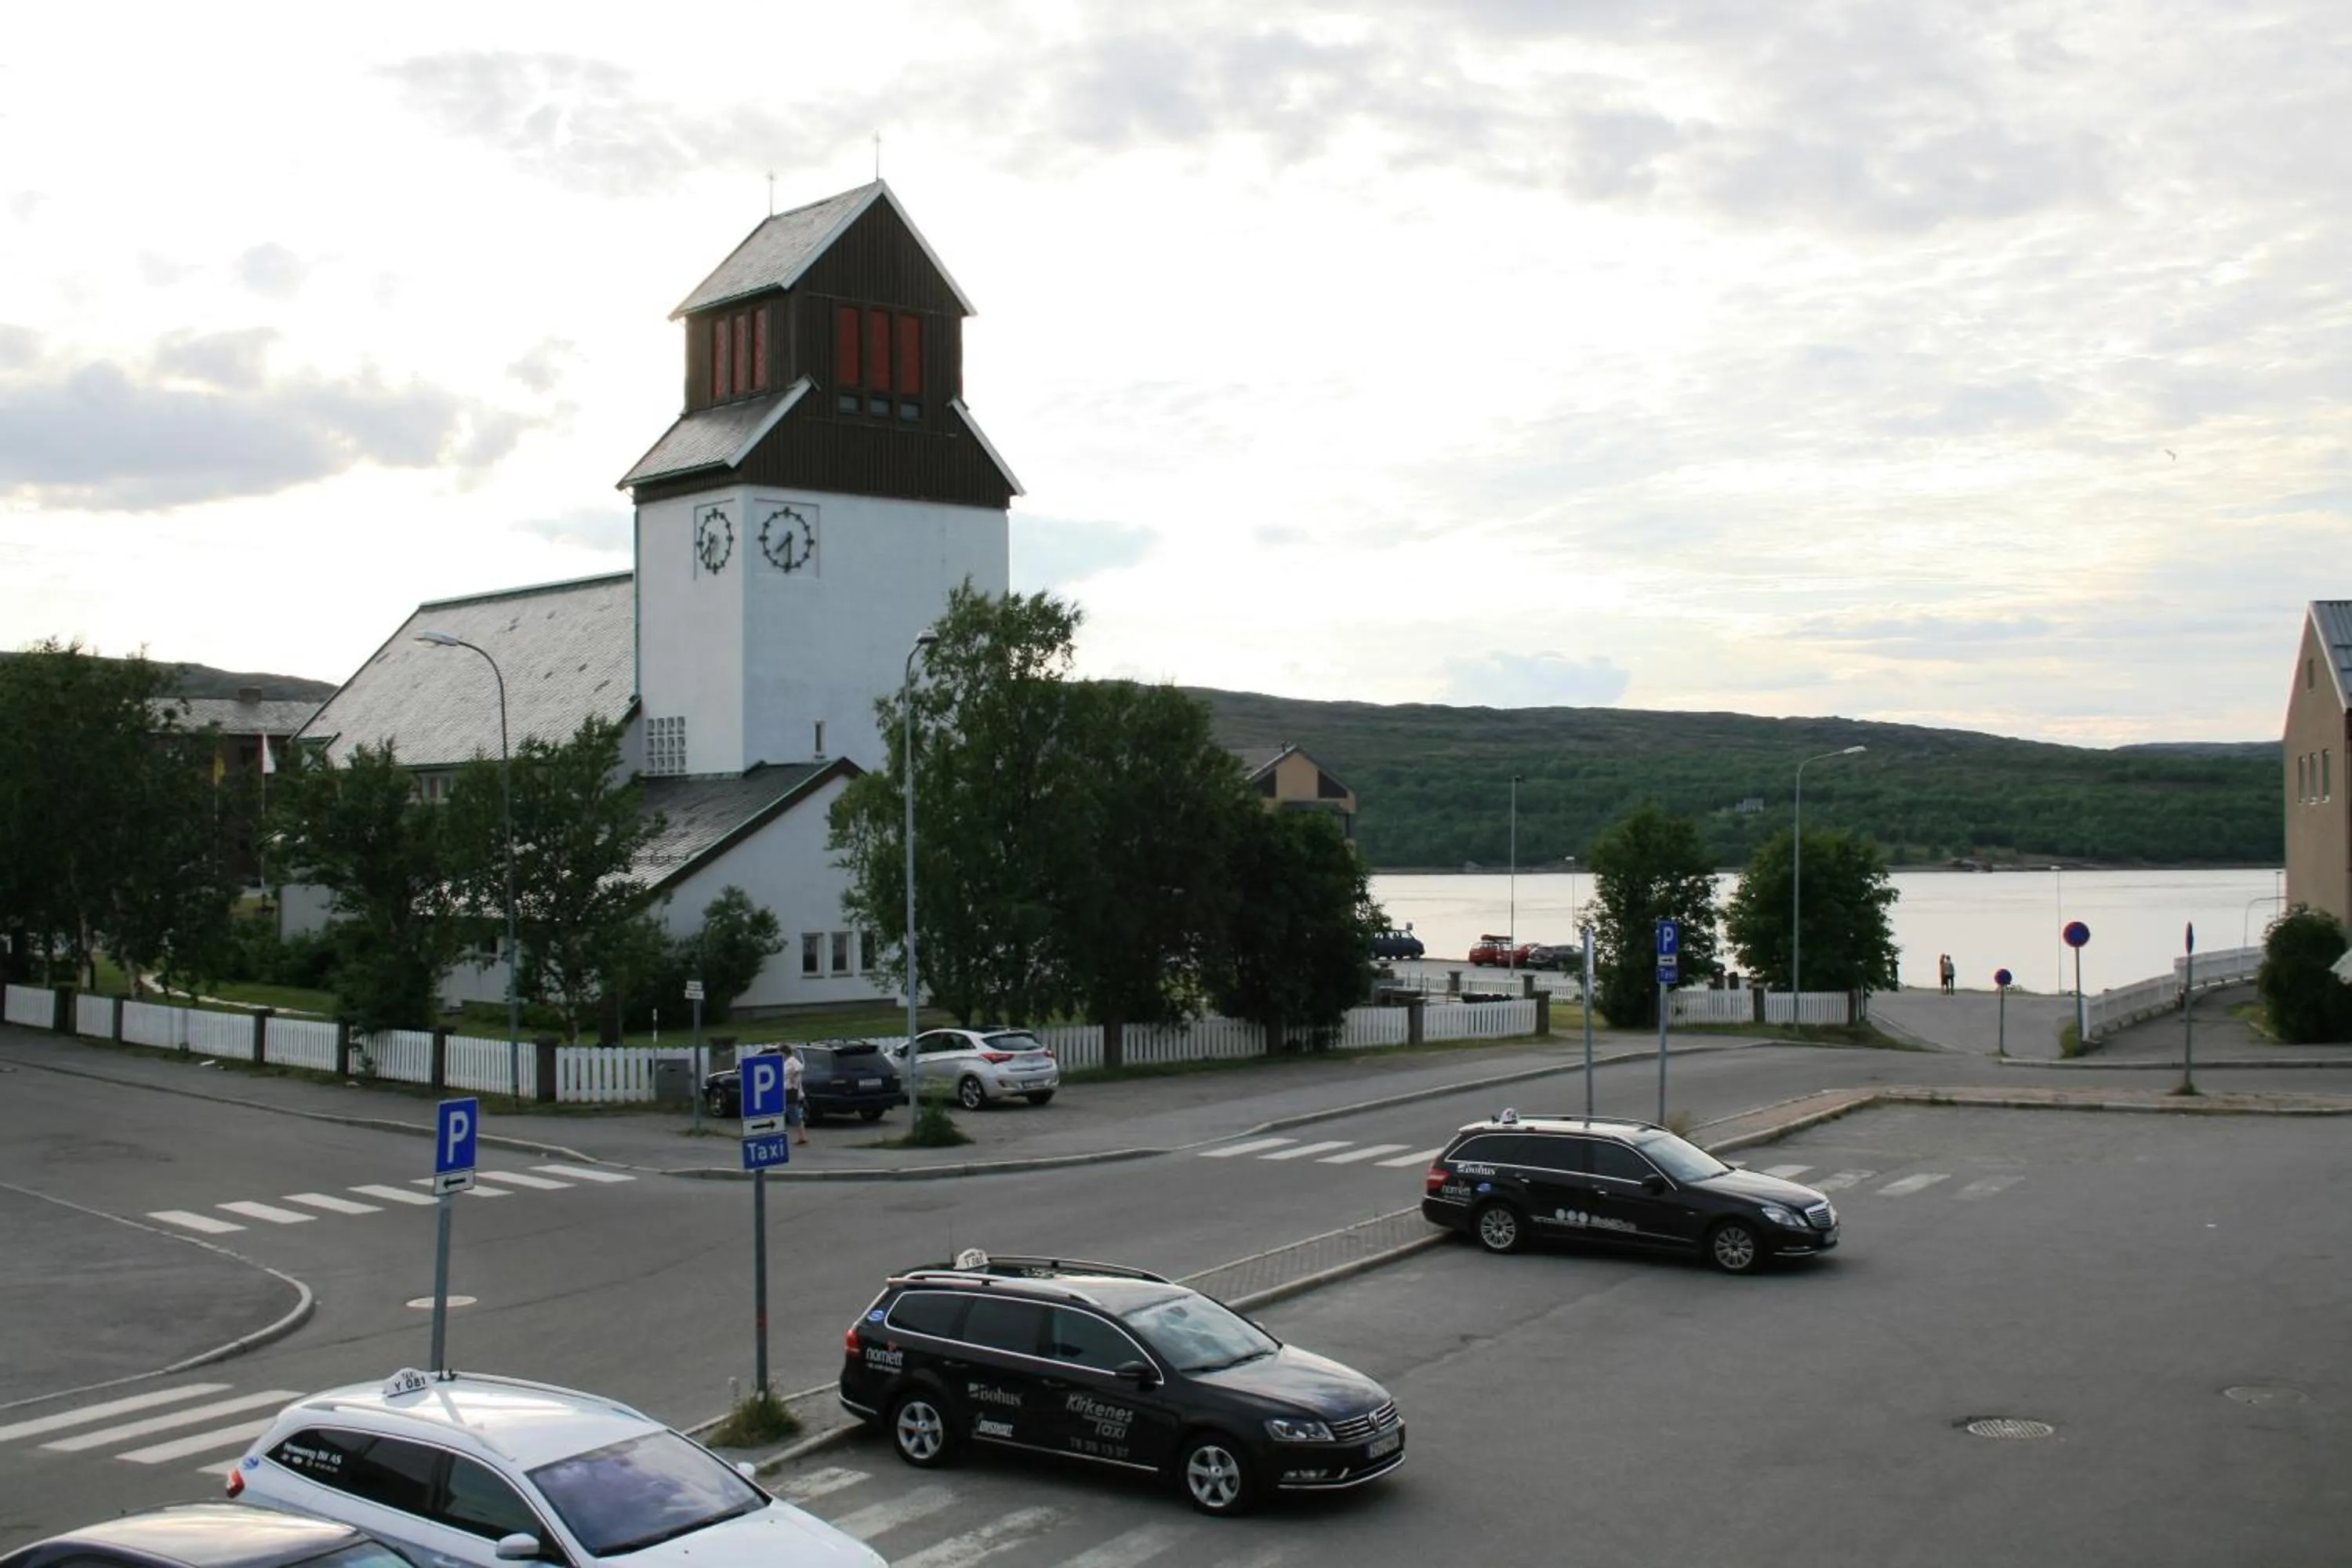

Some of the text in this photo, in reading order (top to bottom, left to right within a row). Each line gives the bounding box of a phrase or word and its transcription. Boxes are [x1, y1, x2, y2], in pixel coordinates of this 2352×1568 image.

[1664, 926, 1674, 952] P
[753, 1063, 776, 1110] P
[447, 1110, 469, 1164] P
[747, 1139, 784, 1163] Taxi
[1066, 1394, 1134, 1423] Kirkenes
[1094, 1420, 1126, 1439] Taxi
